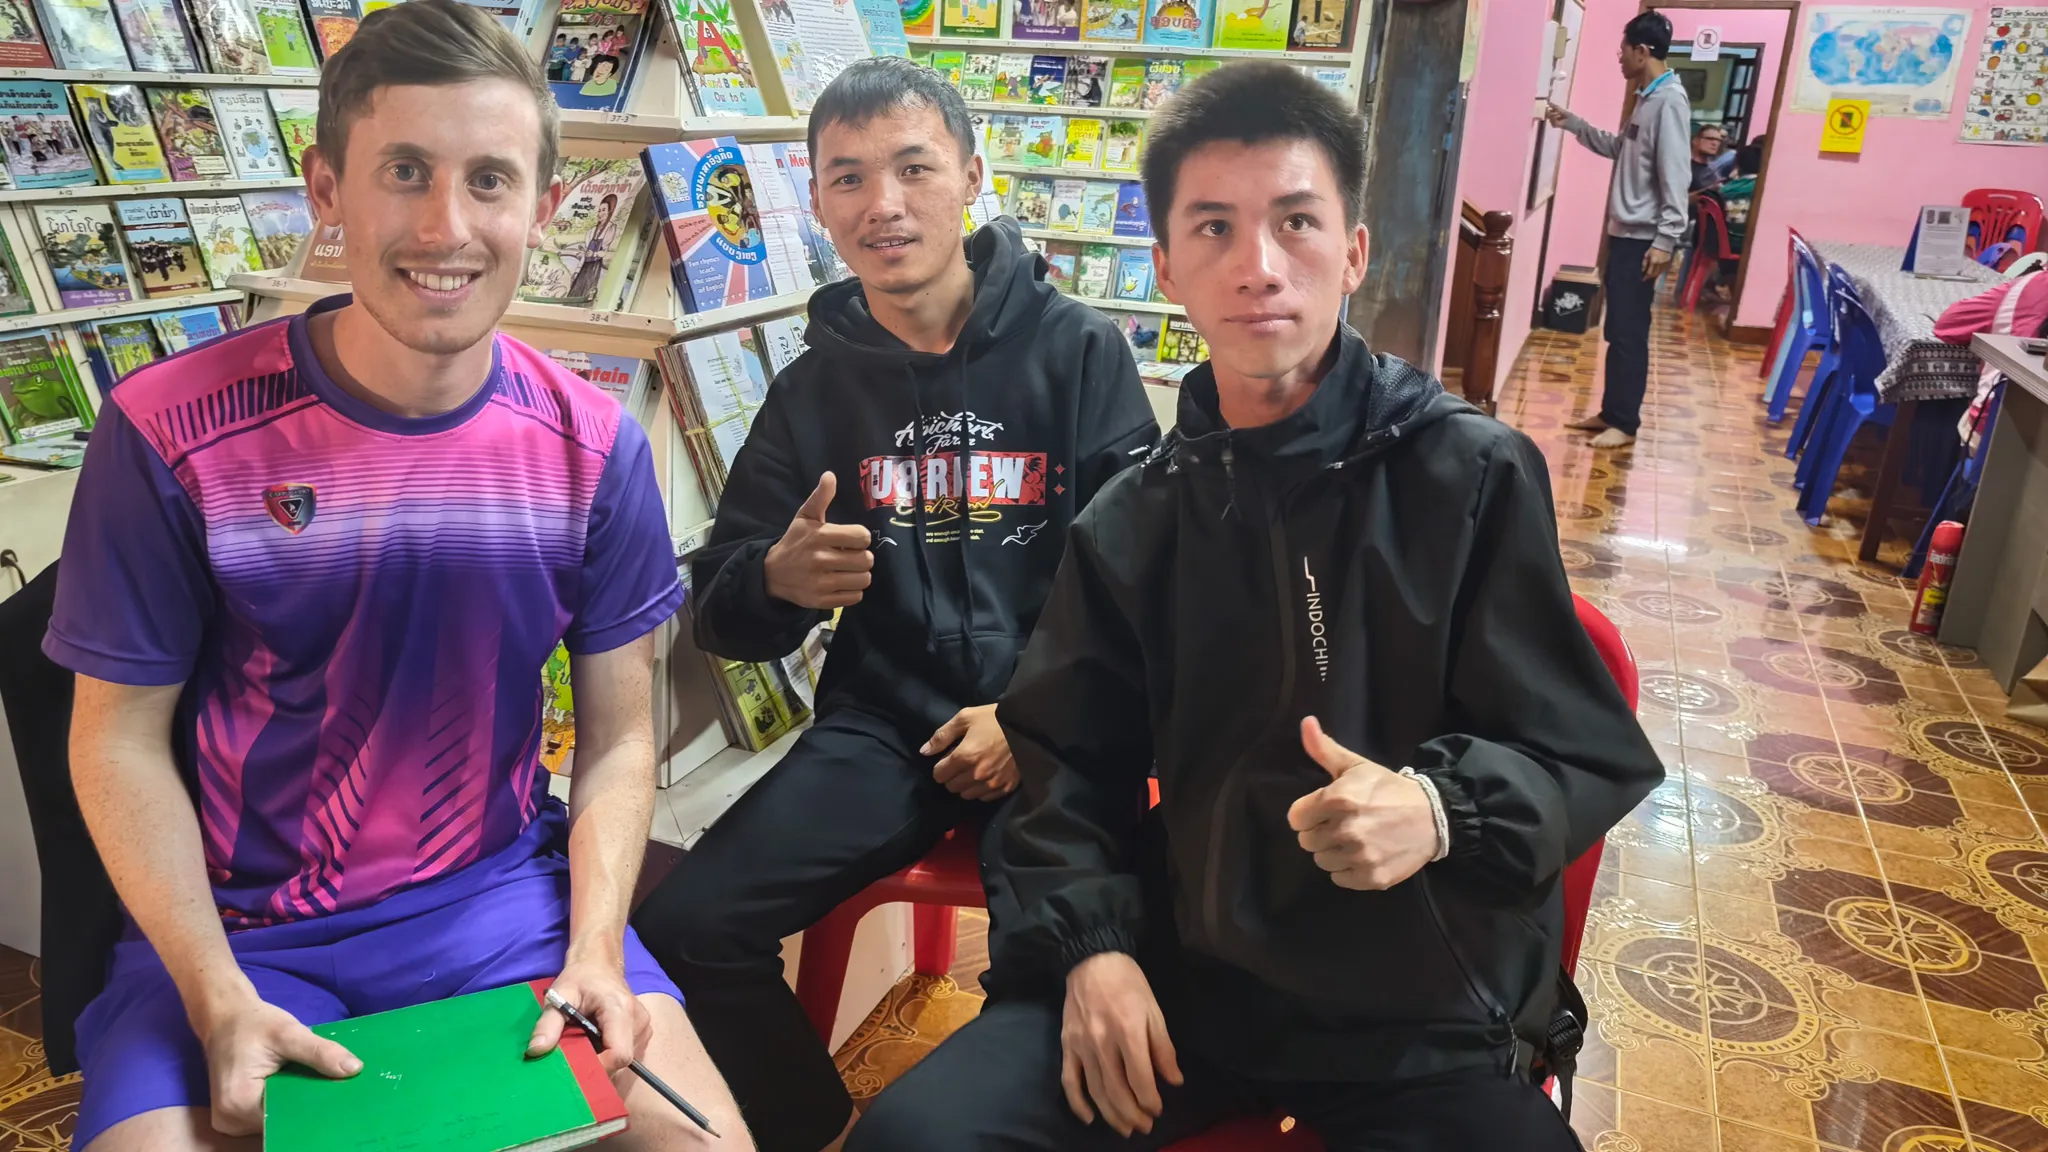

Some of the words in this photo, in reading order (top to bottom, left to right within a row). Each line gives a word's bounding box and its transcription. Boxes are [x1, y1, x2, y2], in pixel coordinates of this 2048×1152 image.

[610, 114, 629, 123] 37-3
[700, 257, 720, 266] rhymes
[272, 280, 287, 288] 38-1
[706, 283, 725, 293] English
[589, 313, 609, 323] 38-4
[680, 319, 696, 329] 23-1
